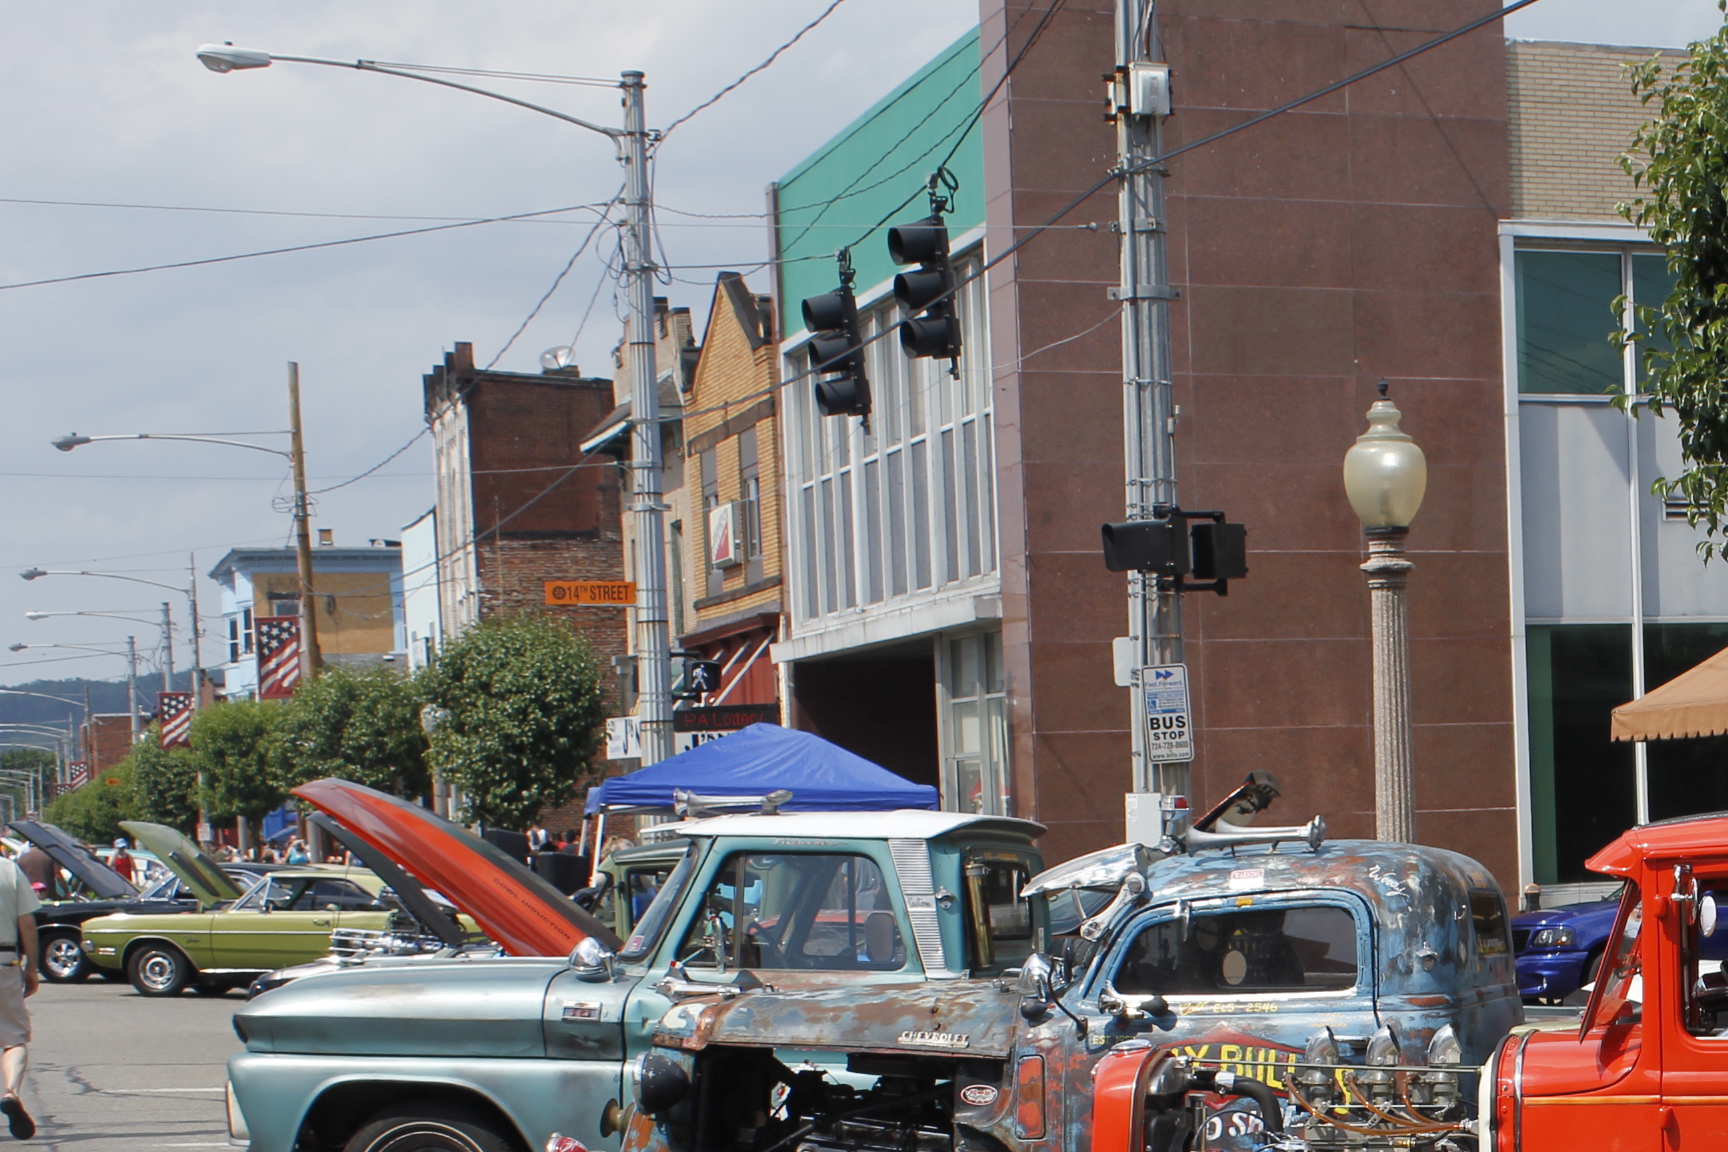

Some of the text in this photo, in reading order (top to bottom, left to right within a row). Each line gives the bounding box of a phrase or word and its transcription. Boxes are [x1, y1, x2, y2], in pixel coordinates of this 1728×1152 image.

[567, 585, 629, 600] 14TH STREET
[685, 713, 708, 726] PA
[1149, 715, 1186, 730] BUS
[1153, 731, 1185, 741] STOP
[1234, 870, 1261, 879] WARNING
[493, 878, 571, 941] COWL INDUCTION
[1245, 1002, 1278, 1013] 2546
[901, 1031, 969, 1043] CHEVROLET
[1092, 1034, 1112, 1045] EST
